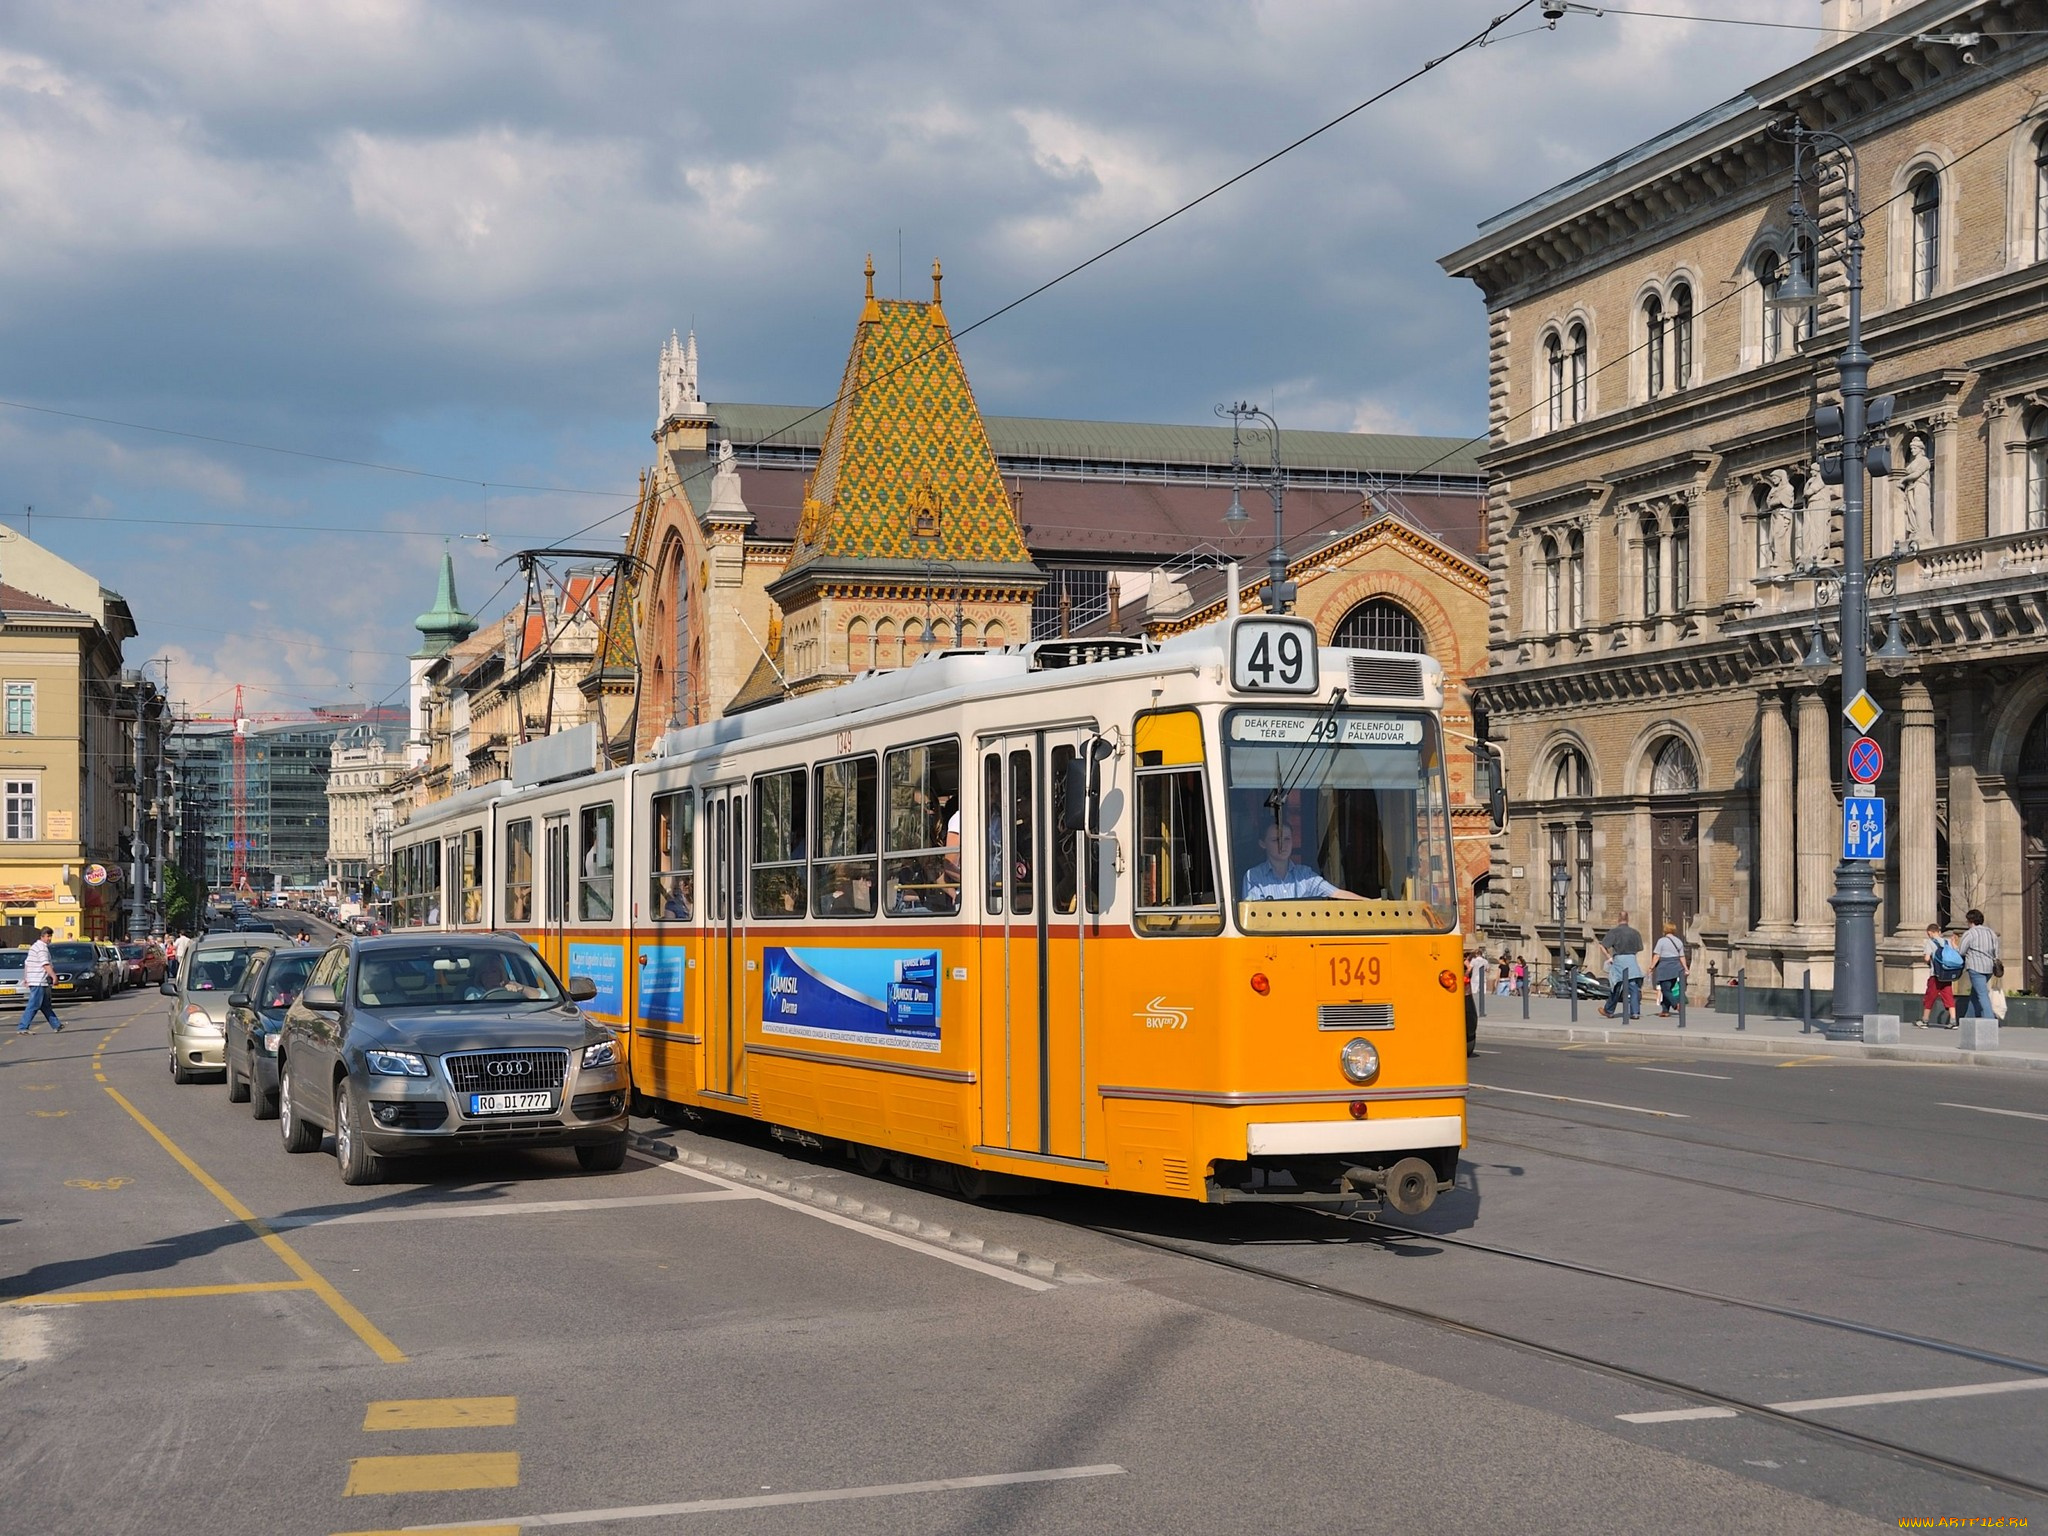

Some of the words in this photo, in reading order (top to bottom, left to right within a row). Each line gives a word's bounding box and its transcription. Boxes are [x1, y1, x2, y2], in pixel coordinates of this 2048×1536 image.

[1248, 632, 1303, 684] 49
[1244, 718, 1270, 728] DEÁK
[1270, 720, 1305, 729] FERENC
[1311, 720, 1338, 739] 49
[1350, 721, 1404, 731] KELENFÖLDI
[1260, 728, 1277, 738] TÉR
[1348, 730, 1404, 741] PÁLYAUDVAR
[836, 731, 852, 755] 1349
[87, 872, 105, 881] KING
[1329, 957, 1381, 986] 1349
[771, 975, 798, 994] LAMISIL
[781, 998, 798, 1014] Derma
[1146, 1017, 1164, 1029] BKV
[480, 1097, 495, 1109] RO
[504, 1095, 517, 1108] DI
[520, 1094, 548, 1104] 7777
